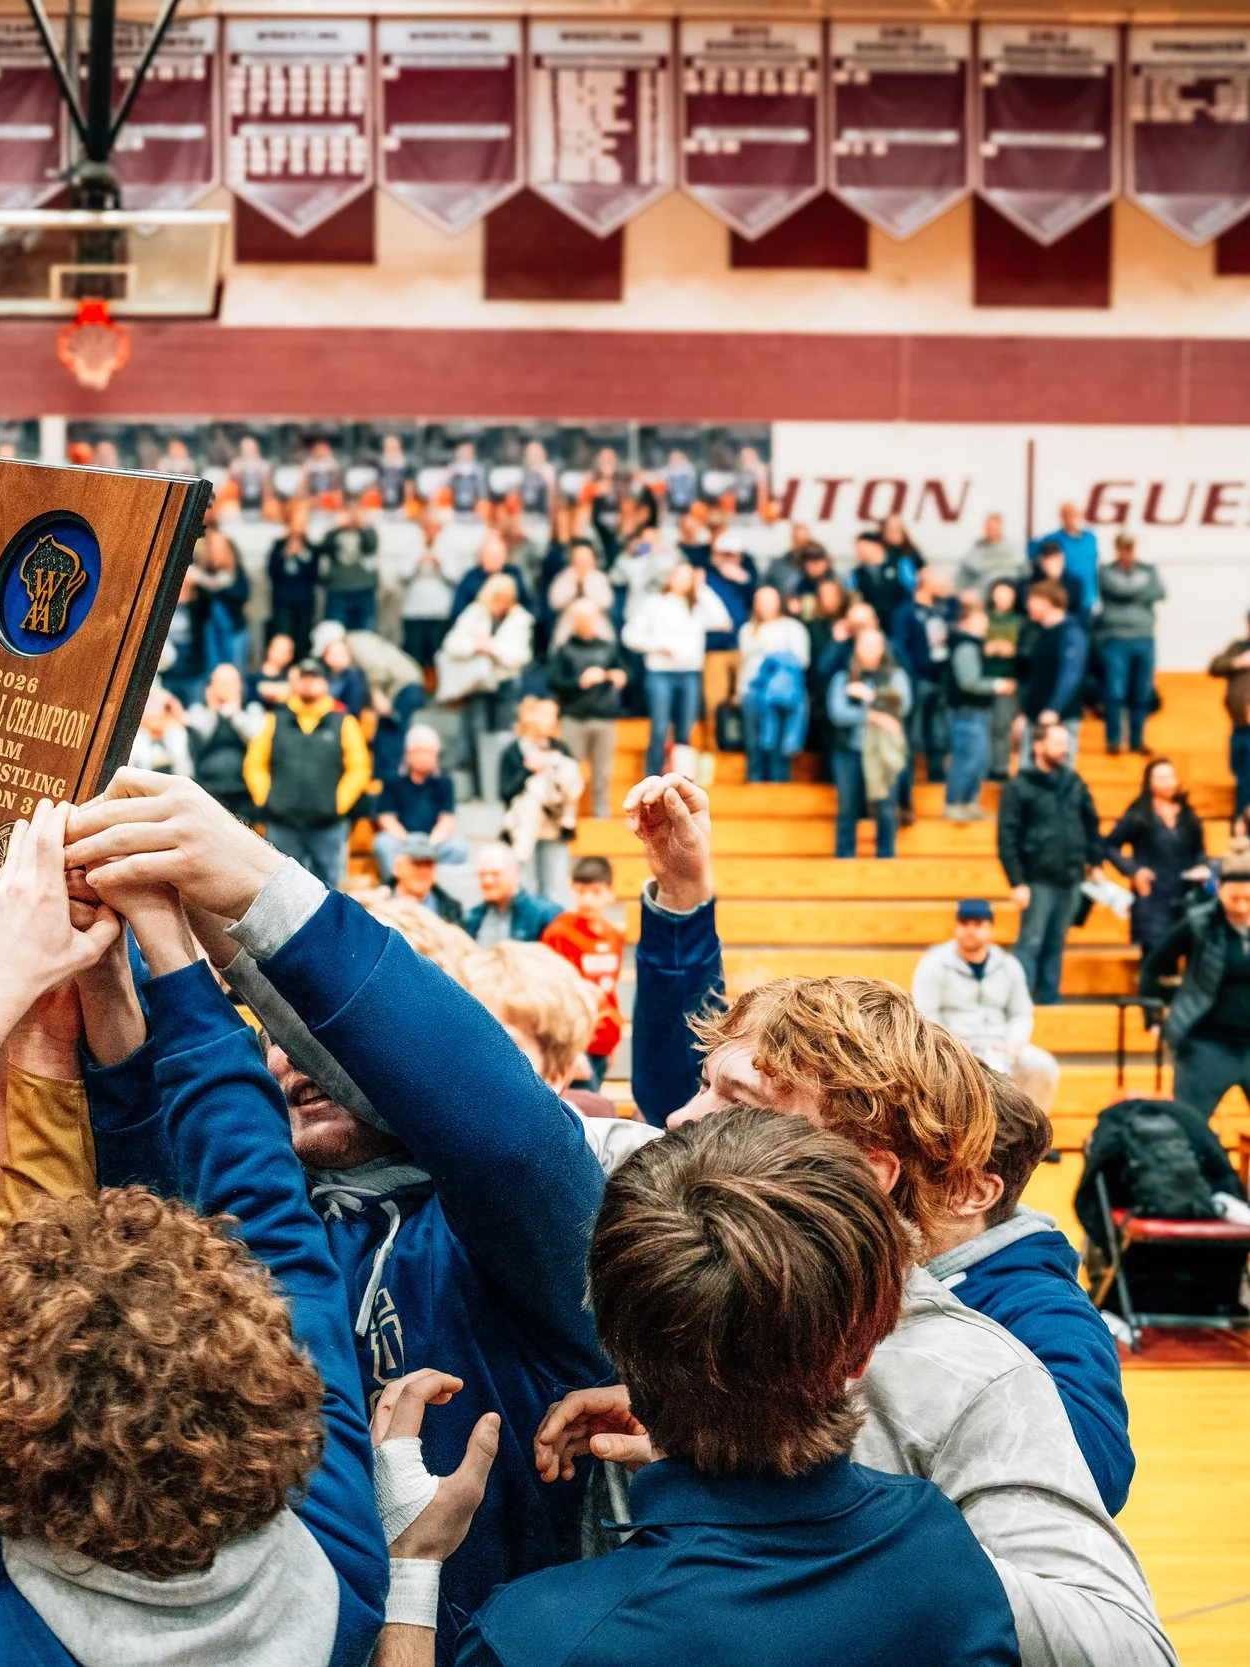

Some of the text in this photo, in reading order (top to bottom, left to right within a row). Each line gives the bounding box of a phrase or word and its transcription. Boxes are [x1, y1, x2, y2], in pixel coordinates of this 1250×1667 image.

[1085, 480, 1250, 526] GUE
[6, 696, 90, 750] CHAMPION
[20, 796, 34, 815] 3
